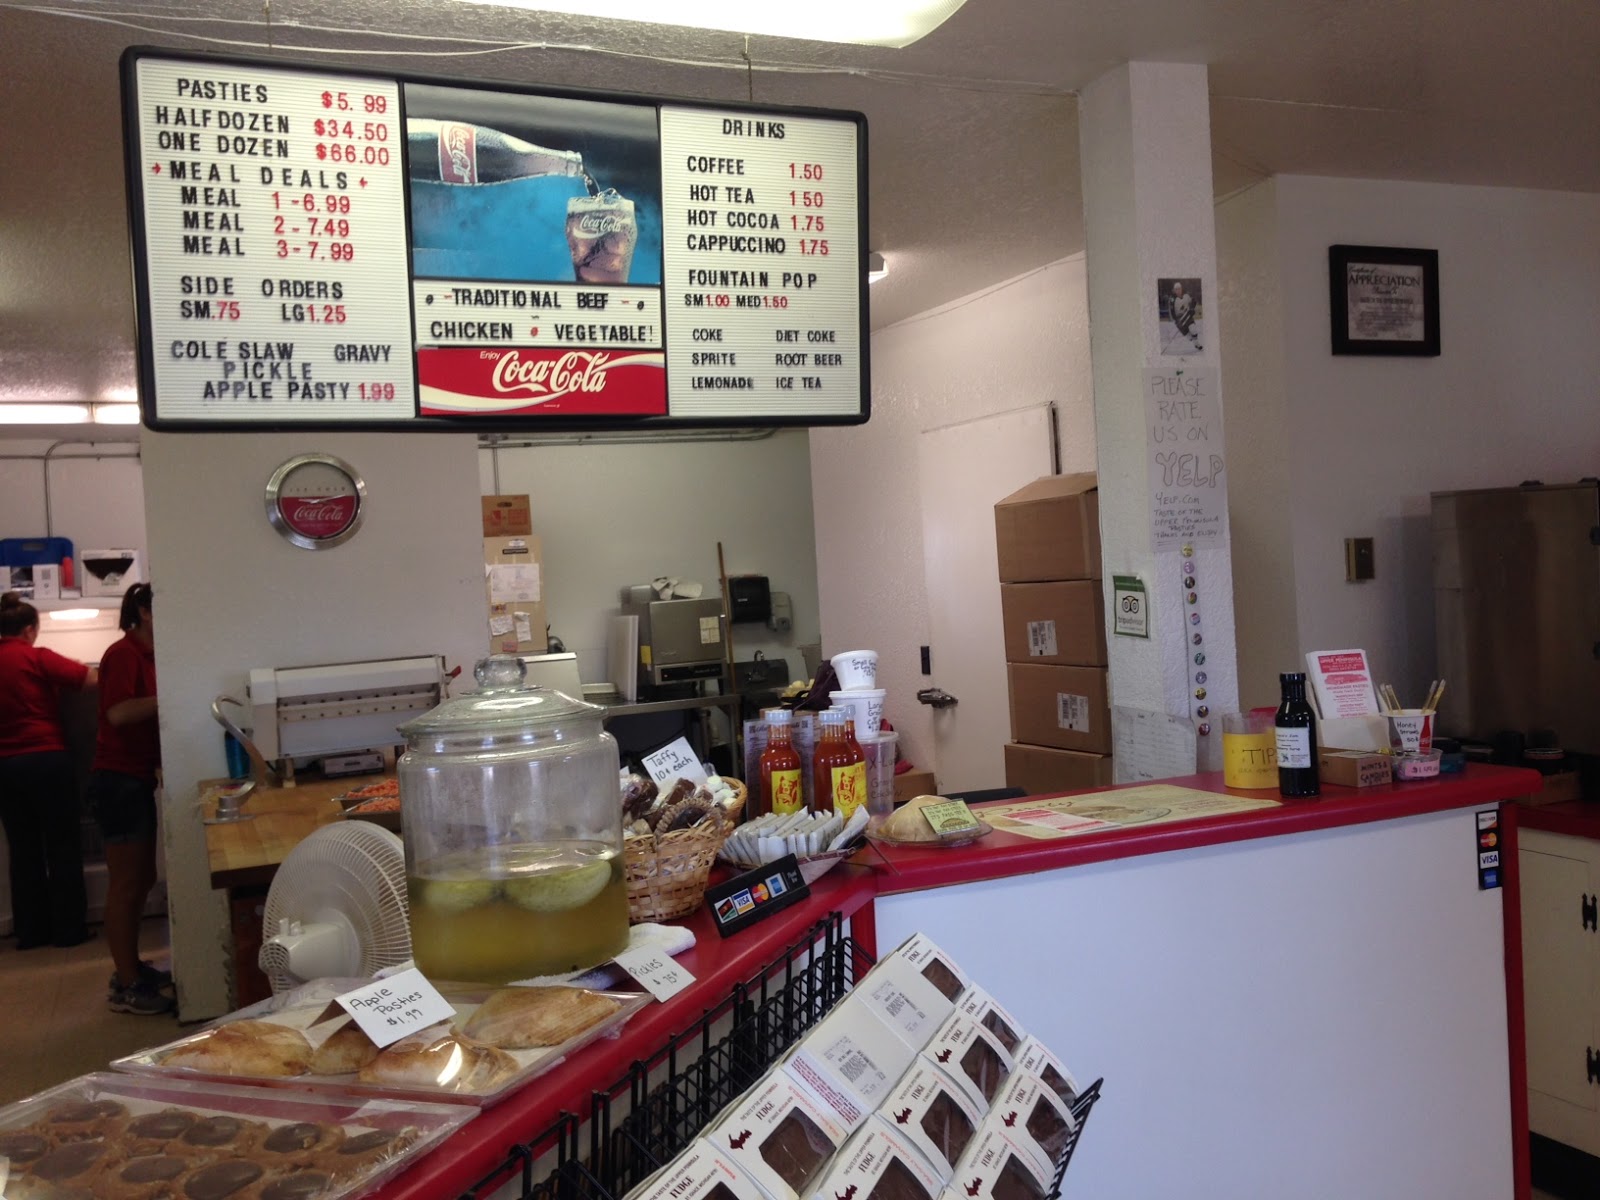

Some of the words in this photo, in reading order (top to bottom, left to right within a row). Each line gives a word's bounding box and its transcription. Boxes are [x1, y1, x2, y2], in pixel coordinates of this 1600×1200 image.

[178, 78, 268, 103] PASTIES
[314, 119, 387, 142] $34.50
[723, 118, 785, 139] DRINKS
[158, 131, 200, 152] ONE
[217, 136, 288, 158] DOZEN
[315, 143, 389, 166] $66.00
[170, 161, 240, 182] MEAL
[261, 166, 348, 190] DEALS
[687, 156, 744, 175] COFFEE
[789, 162, 822, 180] 1.50
[181, 186, 241, 207] MEAL
[690, 185, 718, 201] HOT
[726, 187, 754, 204] TEA
[184, 211, 244, 232] MEAL
[688, 210, 717, 226] HOT
[727, 212, 780, 229] COCOA
[790, 215, 824, 232] 1.75
[183, 236, 246, 256] MEAL
[687, 234, 786, 254] CAPPUCCINO
[800, 239, 829, 255] 1.75
[181, 276, 234, 295] SIDE
[262, 279, 343, 299] ORDERS
[689, 269, 768, 287] FOUNTAIN
[782, 272, 817, 288] POP
[1348, 275, 1420, 286] APPRECIATION
[452, 288, 562, 308] TRADITIONAL
[577, 292, 608, 309] BEEF
[430, 321, 512, 340] CHICKEN
[555, 324, 652, 342] VEGETABLE!
[693, 328, 723, 342] COKE
[776, 330, 800, 342] DIET
[808, 330, 836, 342] COKE
[171, 341, 226, 359] COLE
[239, 342, 294, 360] SLAW
[335, 344, 390, 362] GRAVY
[692, 353, 736, 366] SPRITE
[776, 354, 806, 366] ROOT
[815, 354, 842, 366] BEER
[224, 362, 312, 380] PICKLE
[480, 350, 500, 360] Enjoy
[492, 350, 609, 393] Coca-Cola
[204, 381, 273, 400] APPLE
[288, 382, 350, 400] PASTY
[358, 383, 394, 400] 1.99
[692, 377, 754, 390] LEMONADE
[776, 377, 794, 389] ICE
[802, 378, 822, 389] TEA
[1152, 376, 1207, 396] PLEASE
[1158, 400, 1201, 421] RATE
[1154, 425, 1178, 444] US
[1187, 422, 1208, 440] ON
[1156, 452, 1224, 488] YELP
[646, 750, 679, 767] Taffy
[673, 756, 693, 772] each
[1242, 748, 1277, 764] TIP
[1482, 854, 1498, 864] VISA
[737, 896, 750, 907] VISA
[628, 958, 664, 978] Pickles
[350, 988, 392, 1010] Apple
[373, 991, 423, 1015] Pasties
[387, 1008, 423, 1026] $1.99
[756, 1101, 775, 1120] FUDGE
[858, 1152, 876, 1173] FUDGE
[656, 1187, 666, 1198] TASTE
[674, 1170, 684, 1179] UPPER
[683, 1154, 700, 1170] PENINSULA
[670, 1175, 694, 1198] FUDGE
